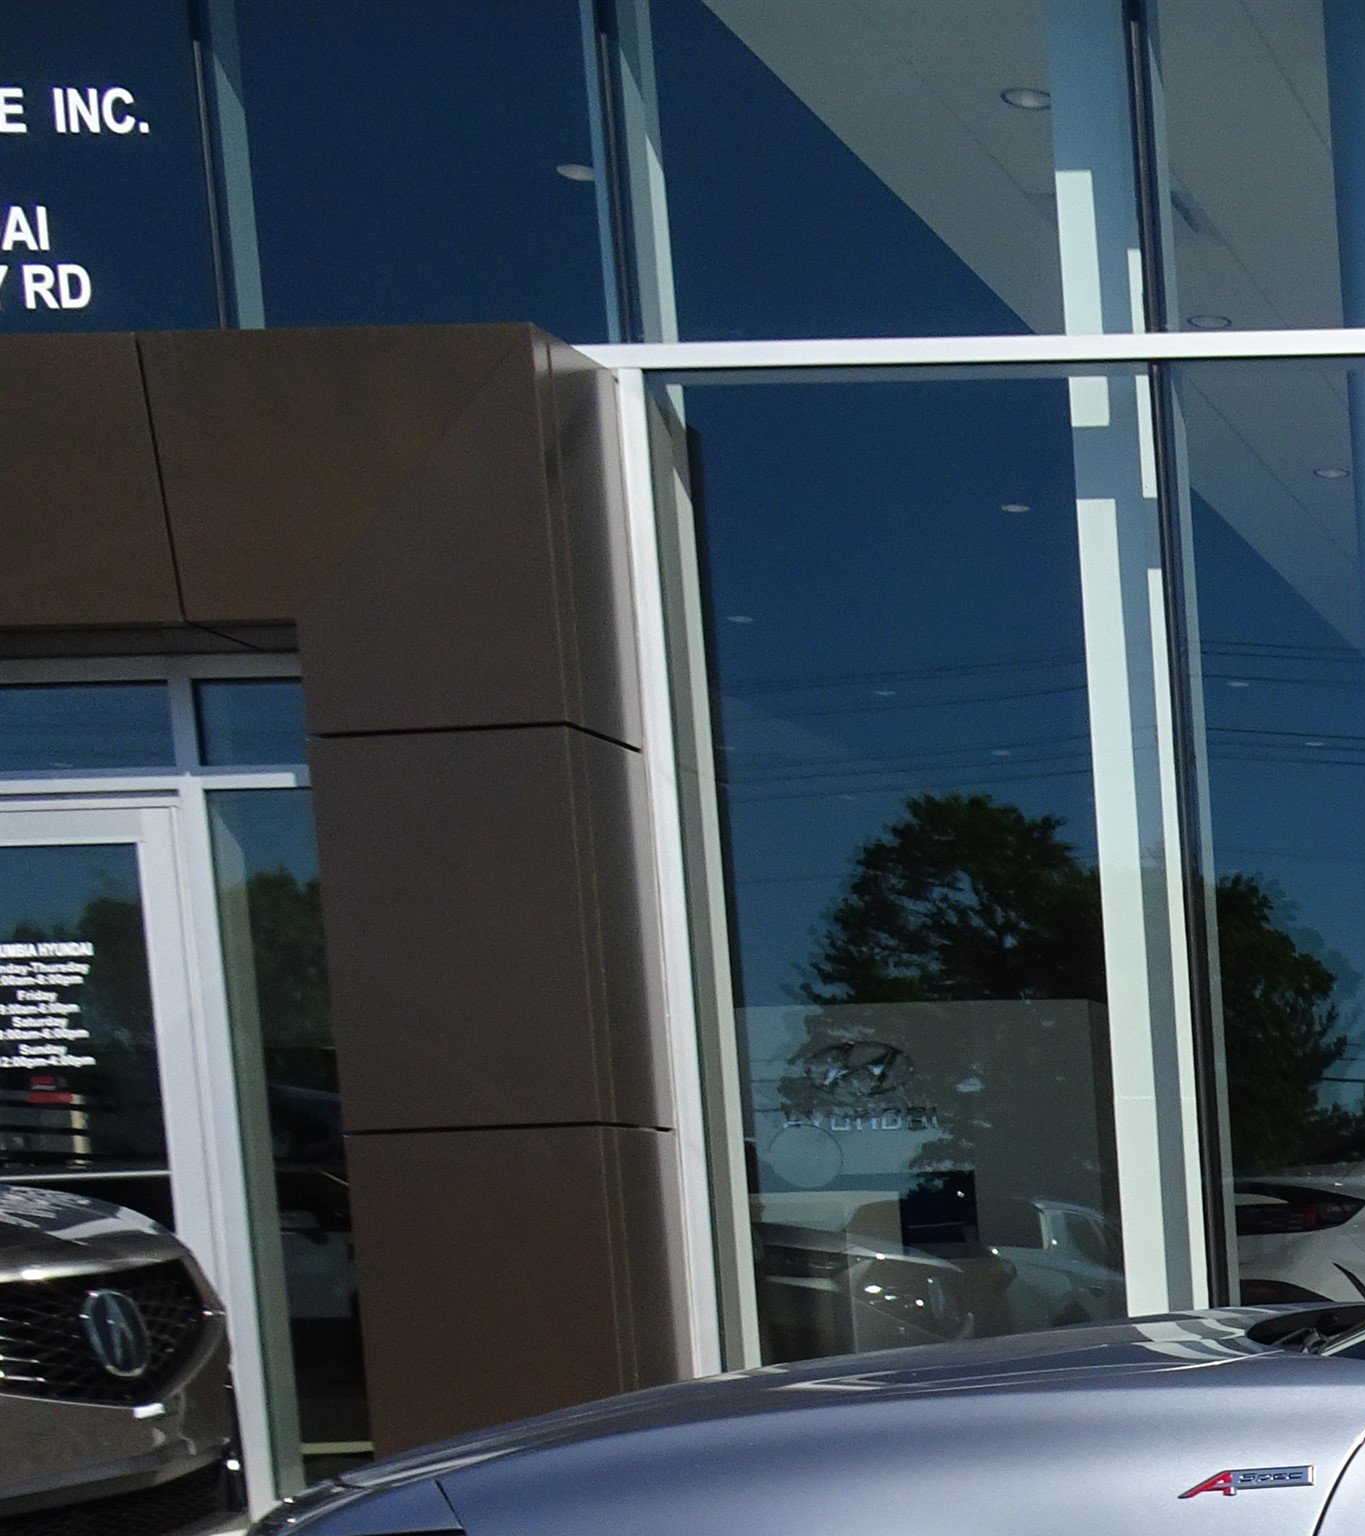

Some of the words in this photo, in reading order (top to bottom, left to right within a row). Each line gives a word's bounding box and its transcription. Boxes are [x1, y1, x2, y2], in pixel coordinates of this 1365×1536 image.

[52, 86, 150, 135] INC.
[23, 263, 92, 310] RD
[38, 942, 94, 957] HYUNDAI
[16, 990, 58, 1003] Friday
[12, 1016, 68, 1029] Saturday
[19, 1044, 67, 1057] Sunday
